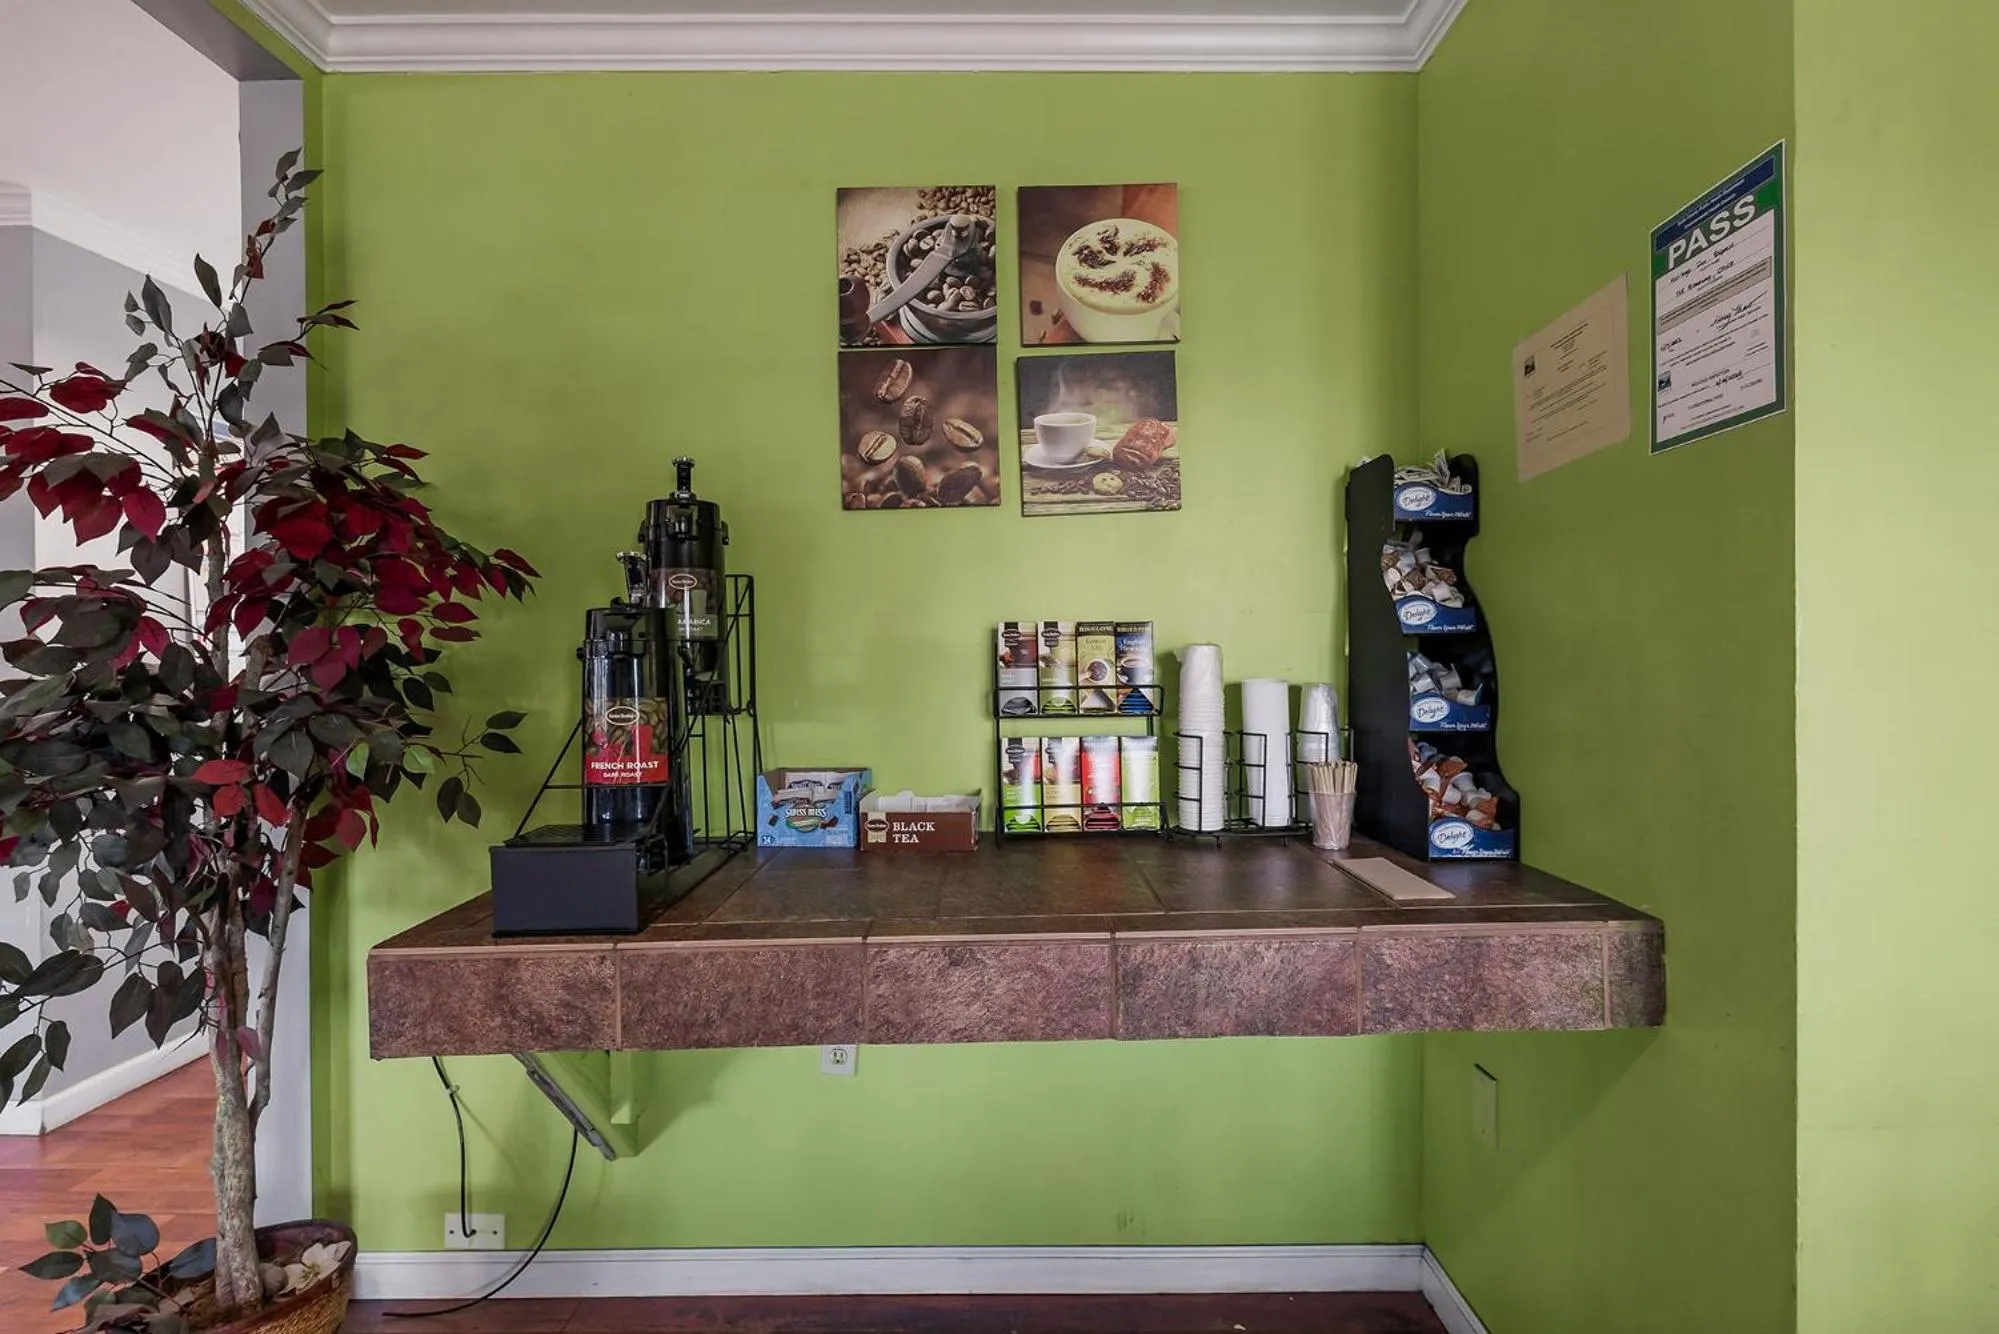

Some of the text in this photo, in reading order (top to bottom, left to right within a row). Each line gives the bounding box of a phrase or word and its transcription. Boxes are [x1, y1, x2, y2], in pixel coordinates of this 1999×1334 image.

[1668, 194, 1756, 270] PASS
[591, 760, 660, 770] FRENCH ROAST
[893, 821, 936, 831] BLACK
[892, 833, 919, 843] TEA
